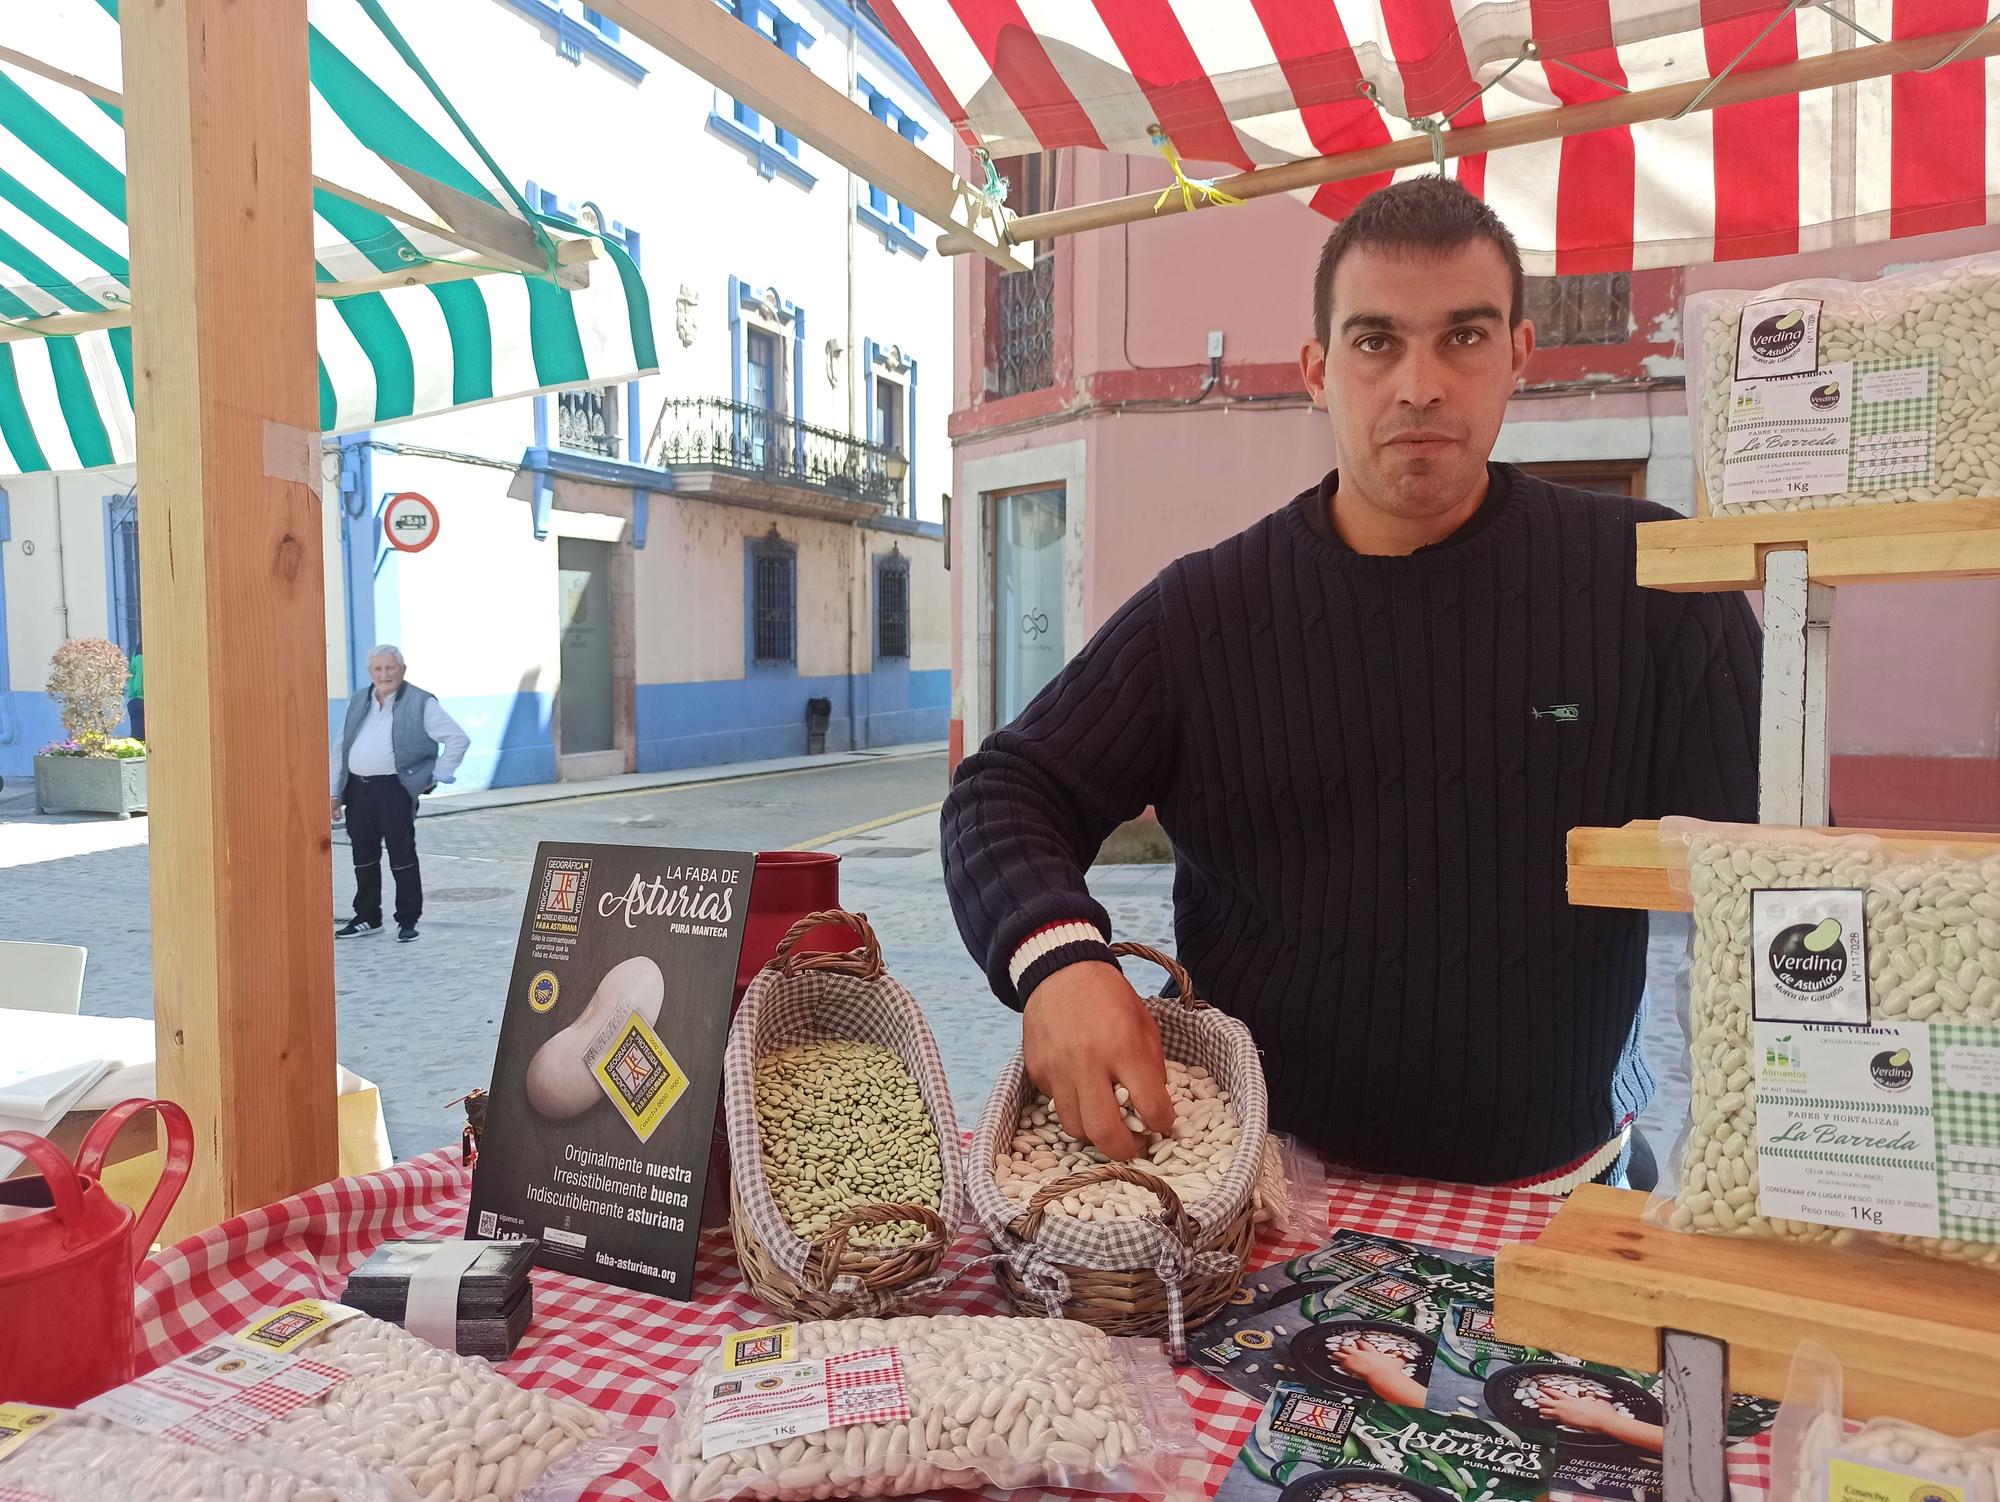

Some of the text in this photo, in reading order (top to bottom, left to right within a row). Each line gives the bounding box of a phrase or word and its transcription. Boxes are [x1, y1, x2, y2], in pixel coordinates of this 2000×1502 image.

[1752, 330, 1802, 346] Verdina
[1756, 340, 1797, 357] de Asturias
[1734, 432, 1839, 455] La Barreda
[1751, 488, 1768, 496] Peso
[1786, 482, 1809, 493] 1Kg
[548, 860, 584, 870] GEOGRÁFICA
[666, 865, 740, 884] LA FABA DE
[539, 869, 553, 912] INDICACIÓN
[574, 870, 588, 914] PROTEGIDA
[598, 872, 733, 929] Asturias
[535, 922, 550, 930] FABA
[669, 922, 728, 938] PURA MANTECA
[1850, 932, 1861, 968] 117028
[1773, 953, 1843, 972] Verdina
[1779, 972, 1838, 991] de Asturias
[1772, 981, 1798, 1001] Marca
[1798, 995, 1809, 1003] de
[1847, 1026, 1900, 1036] VERDINA
[634, 1035, 658, 1067] PROTEGIDA
[1762, 1067, 1807, 1079] Alimentos
[1872, 1066, 1912, 1078] Verdina
[1787, 1110, 1899, 1127] FABES Y HORTALIZAS
[1769, 1121, 1921, 1151] La Barreda
[564, 1144, 692, 1184] Originalmente nuestra
[553, 1165, 689, 1208] Irresistiblemente buena
[1765, 1185, 1805, 1196] CONSERVAR
[1807, 1189, 1816, 1197] EN
[1818, 1191, 1842, 1200] LUGAR
[526, 1183, 685, 1233] Indiscutiblemente asturiana
[1801, 1204, 1883, 1225] Peso neto: 1Kg
[595, 1251, 677, 1284] faba-asturiana.org
[1290, 1392, 1347, 1410] GEOGRÁFICA
[773, 1425, 797, 1436] 1Kg
[1273, 1424, 1342, 1446] FABA ASTURIANA
[1282, 1421, 1343, 1440] CONSEJO REGULADOR
[1358, 1422, 1542, 1470] Asturias
[1450, 1429, 1542, 1452] LA FABA DE
[1463, 1460, 1540, 1480] PURA MANTECA
